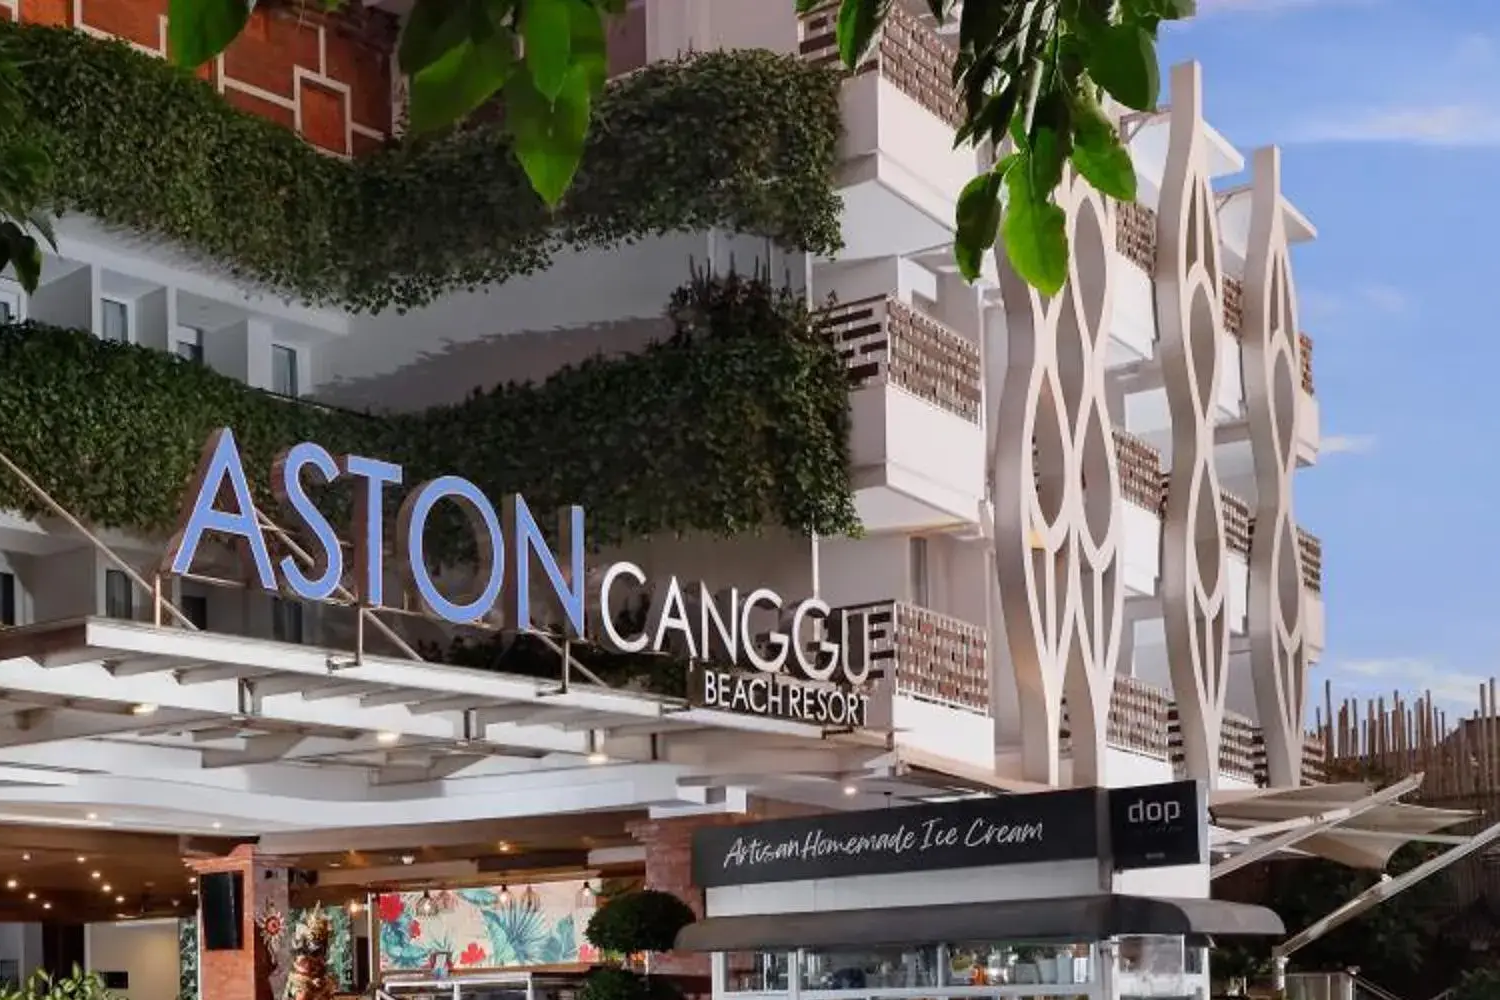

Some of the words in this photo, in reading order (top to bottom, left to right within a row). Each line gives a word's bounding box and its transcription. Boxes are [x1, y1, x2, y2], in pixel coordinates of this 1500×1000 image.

[171, 426, 586, 638] ASTON
[601, 560, 869, 685] CANGGU
[705, 670, 783, 714] BEACH
[789, 685, 869, 726] RESORT
[1128, 799, 1180, 823] dop
[723, 836, 799, 868] Artisan
[800, 828, 915, 860] Homemade
[920, 817, 958, 851] Ice
[964, 817, 1043, 847] Cream
